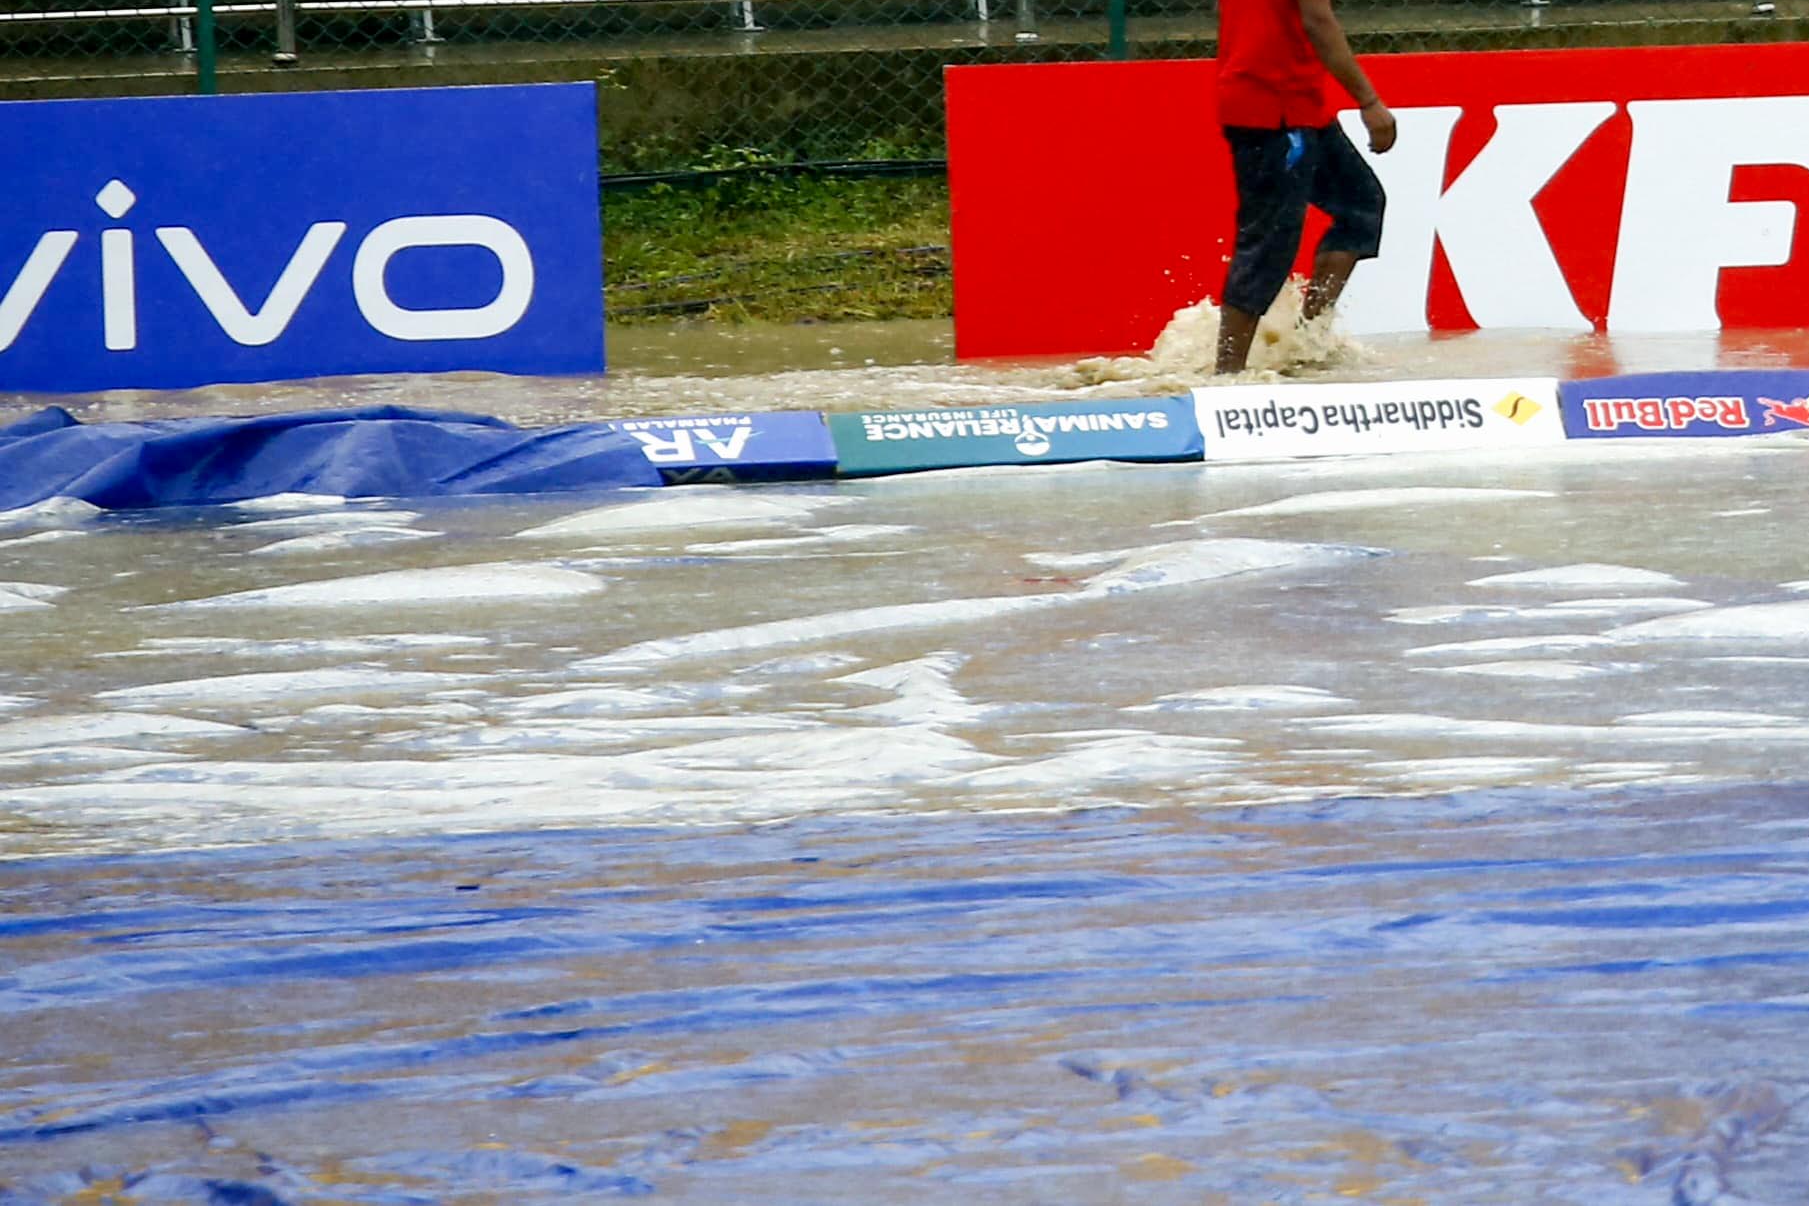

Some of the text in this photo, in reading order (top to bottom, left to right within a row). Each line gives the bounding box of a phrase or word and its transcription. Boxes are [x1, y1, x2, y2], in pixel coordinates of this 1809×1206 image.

[622, 414, 752, 432] PHARMALAB
[861, 407, 1018, 425] LIFE INSURANCE
[864, 411, 1169, 441] SANIMA RELIANCE
[1216, 396, 1484, 438] Siddhartha Capital
[1583, 396, 1751, 431] Red Bull
